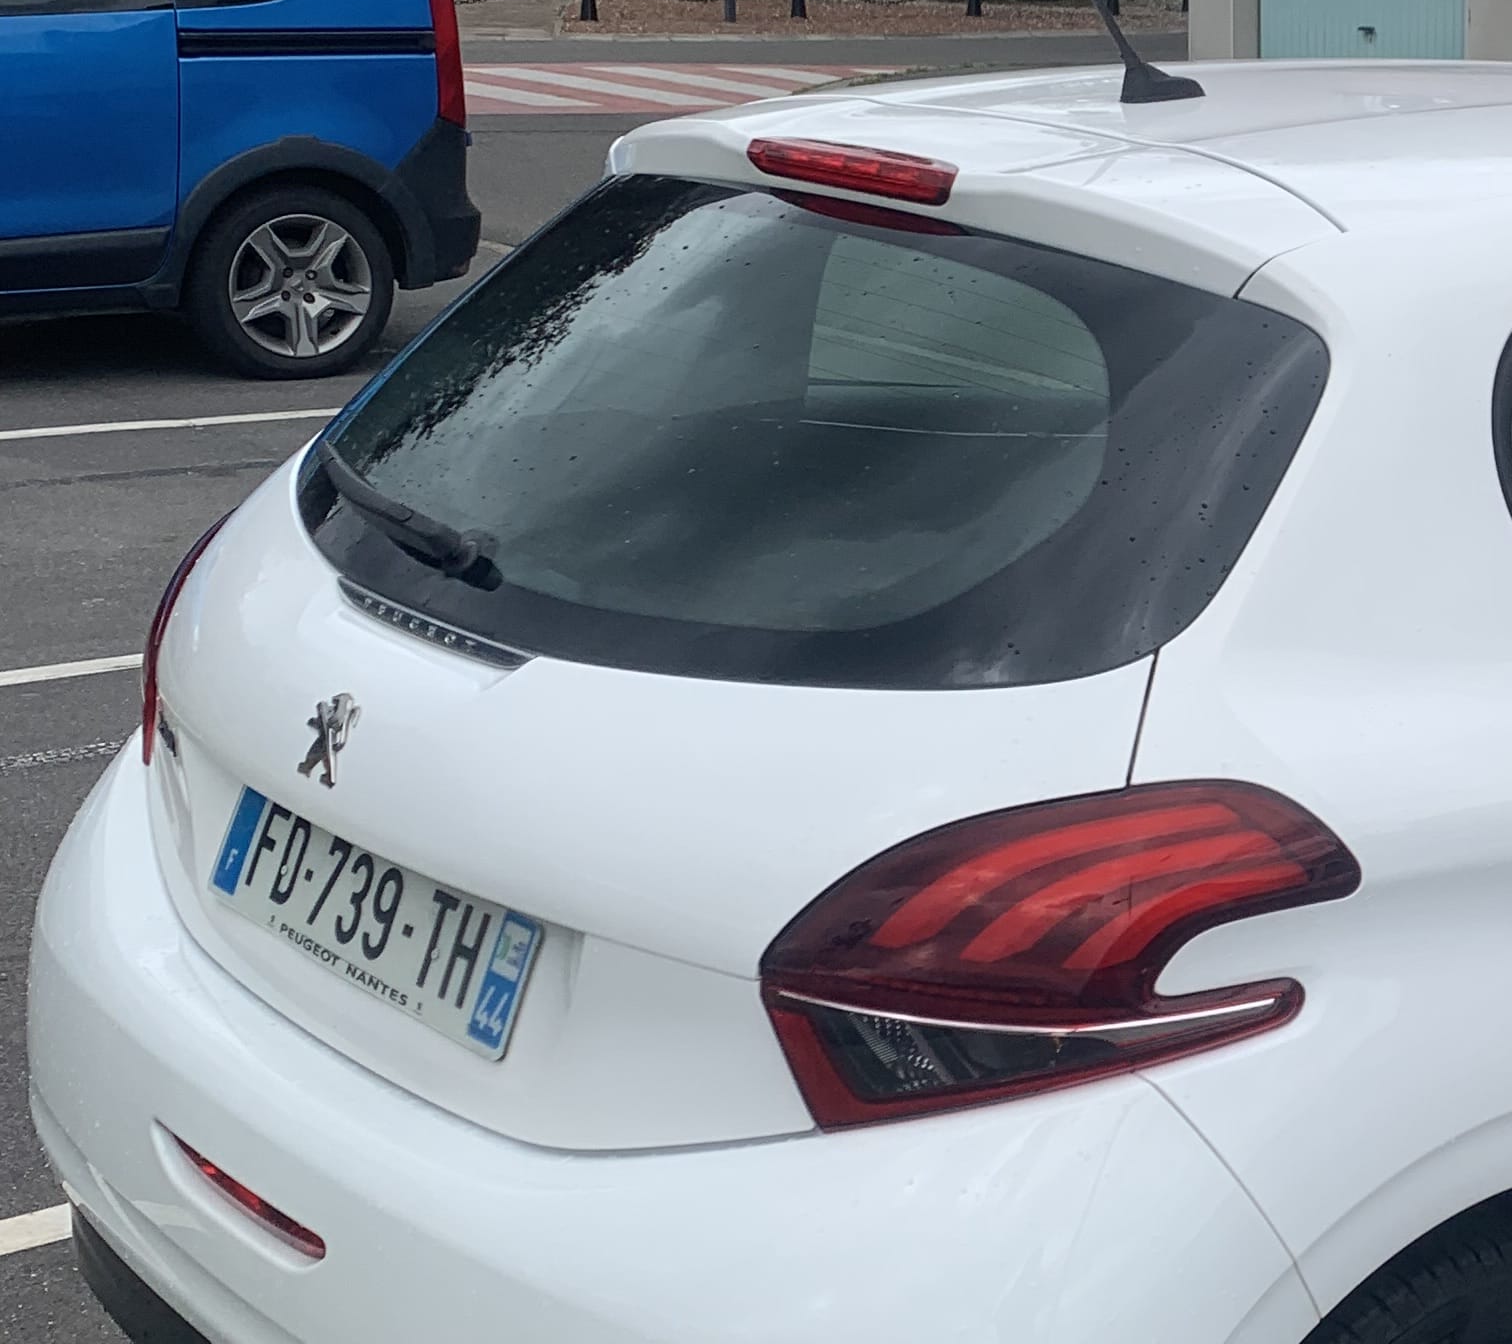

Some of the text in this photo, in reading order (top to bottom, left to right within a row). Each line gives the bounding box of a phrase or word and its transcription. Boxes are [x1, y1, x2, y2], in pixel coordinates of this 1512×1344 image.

[225, 848, 238, 870] F
[245, 801, 491, 1010] FD-739-TH
[280, 923, 408, 1006] PEUGEOT NANTES
[476, 985, 509, 1036] 44
